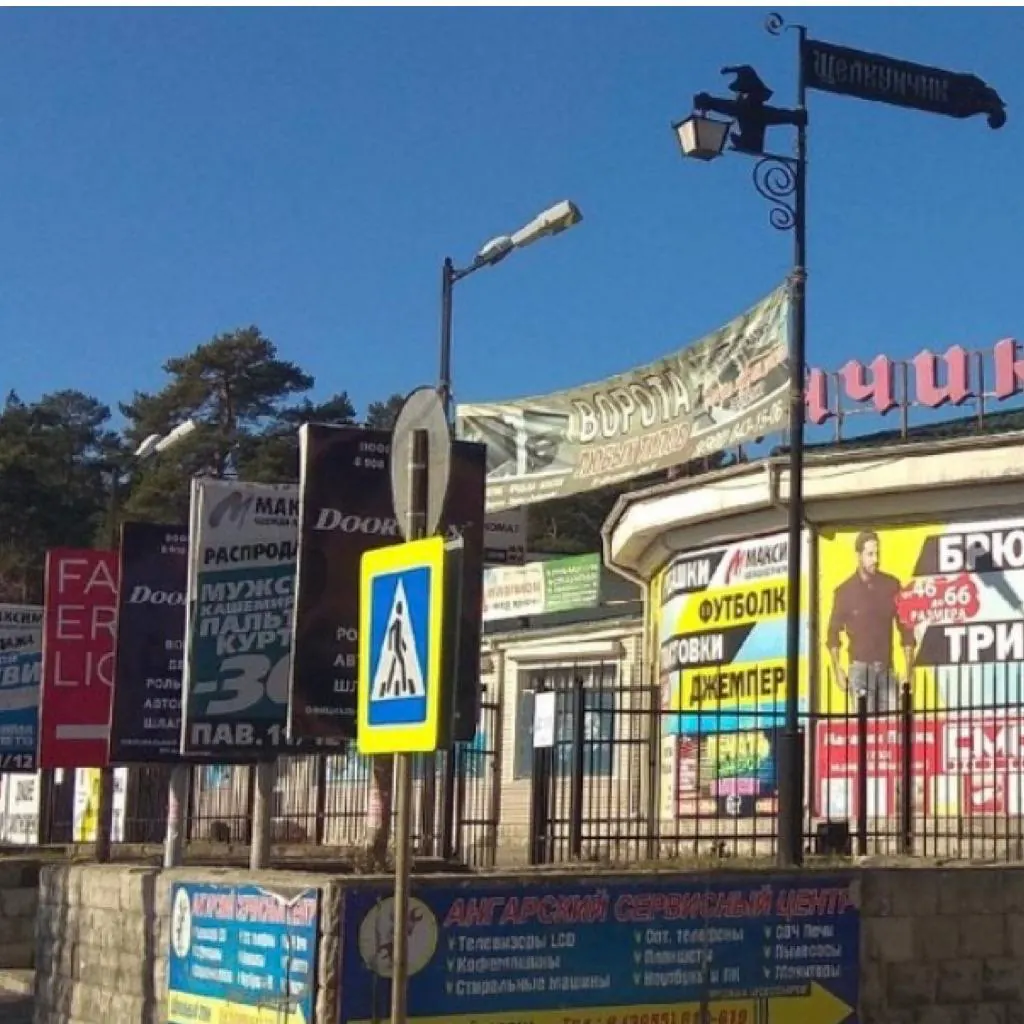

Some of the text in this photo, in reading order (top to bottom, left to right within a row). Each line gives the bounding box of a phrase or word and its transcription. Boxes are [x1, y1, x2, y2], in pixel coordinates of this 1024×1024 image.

[571, 371, 693, 443] ВОРОТА
[58, 559, 119, 594] FA
[912, 579, 937, 598] 46
[699, 587, 786, 625] ФУТБОЛК
[944, 585, 971, 606] 66
[690, 666, 785, 707] ДЖЕМПЕР
[190, 723, 263, 746] ПАВ.
[444, 885, 861, 927] АНГАРСКИЙ СЕРВИСНЫЙ ЦЕНТР
